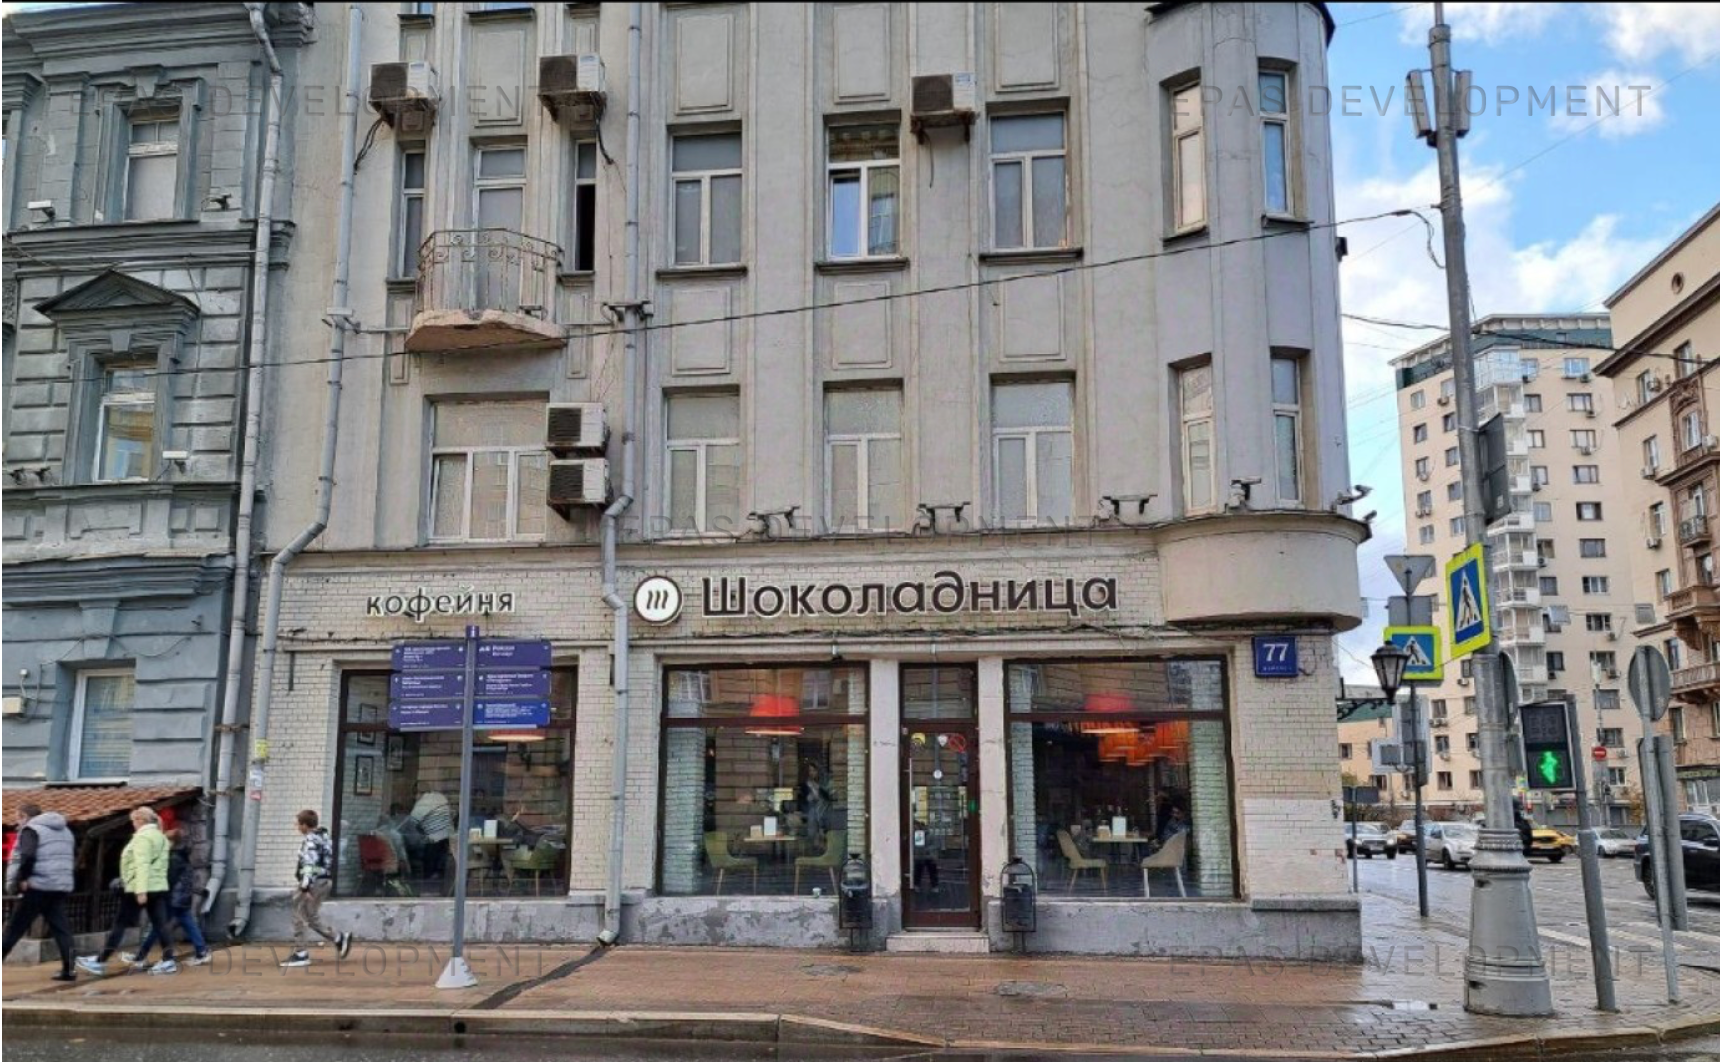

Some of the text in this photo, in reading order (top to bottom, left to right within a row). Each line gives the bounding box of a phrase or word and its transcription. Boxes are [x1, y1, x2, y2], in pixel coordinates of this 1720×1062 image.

[366, 585, 516, 623] кофейня
[701, 571, 1119, 618] Шоколадница
[1262, 643, 1289, 662] 77
